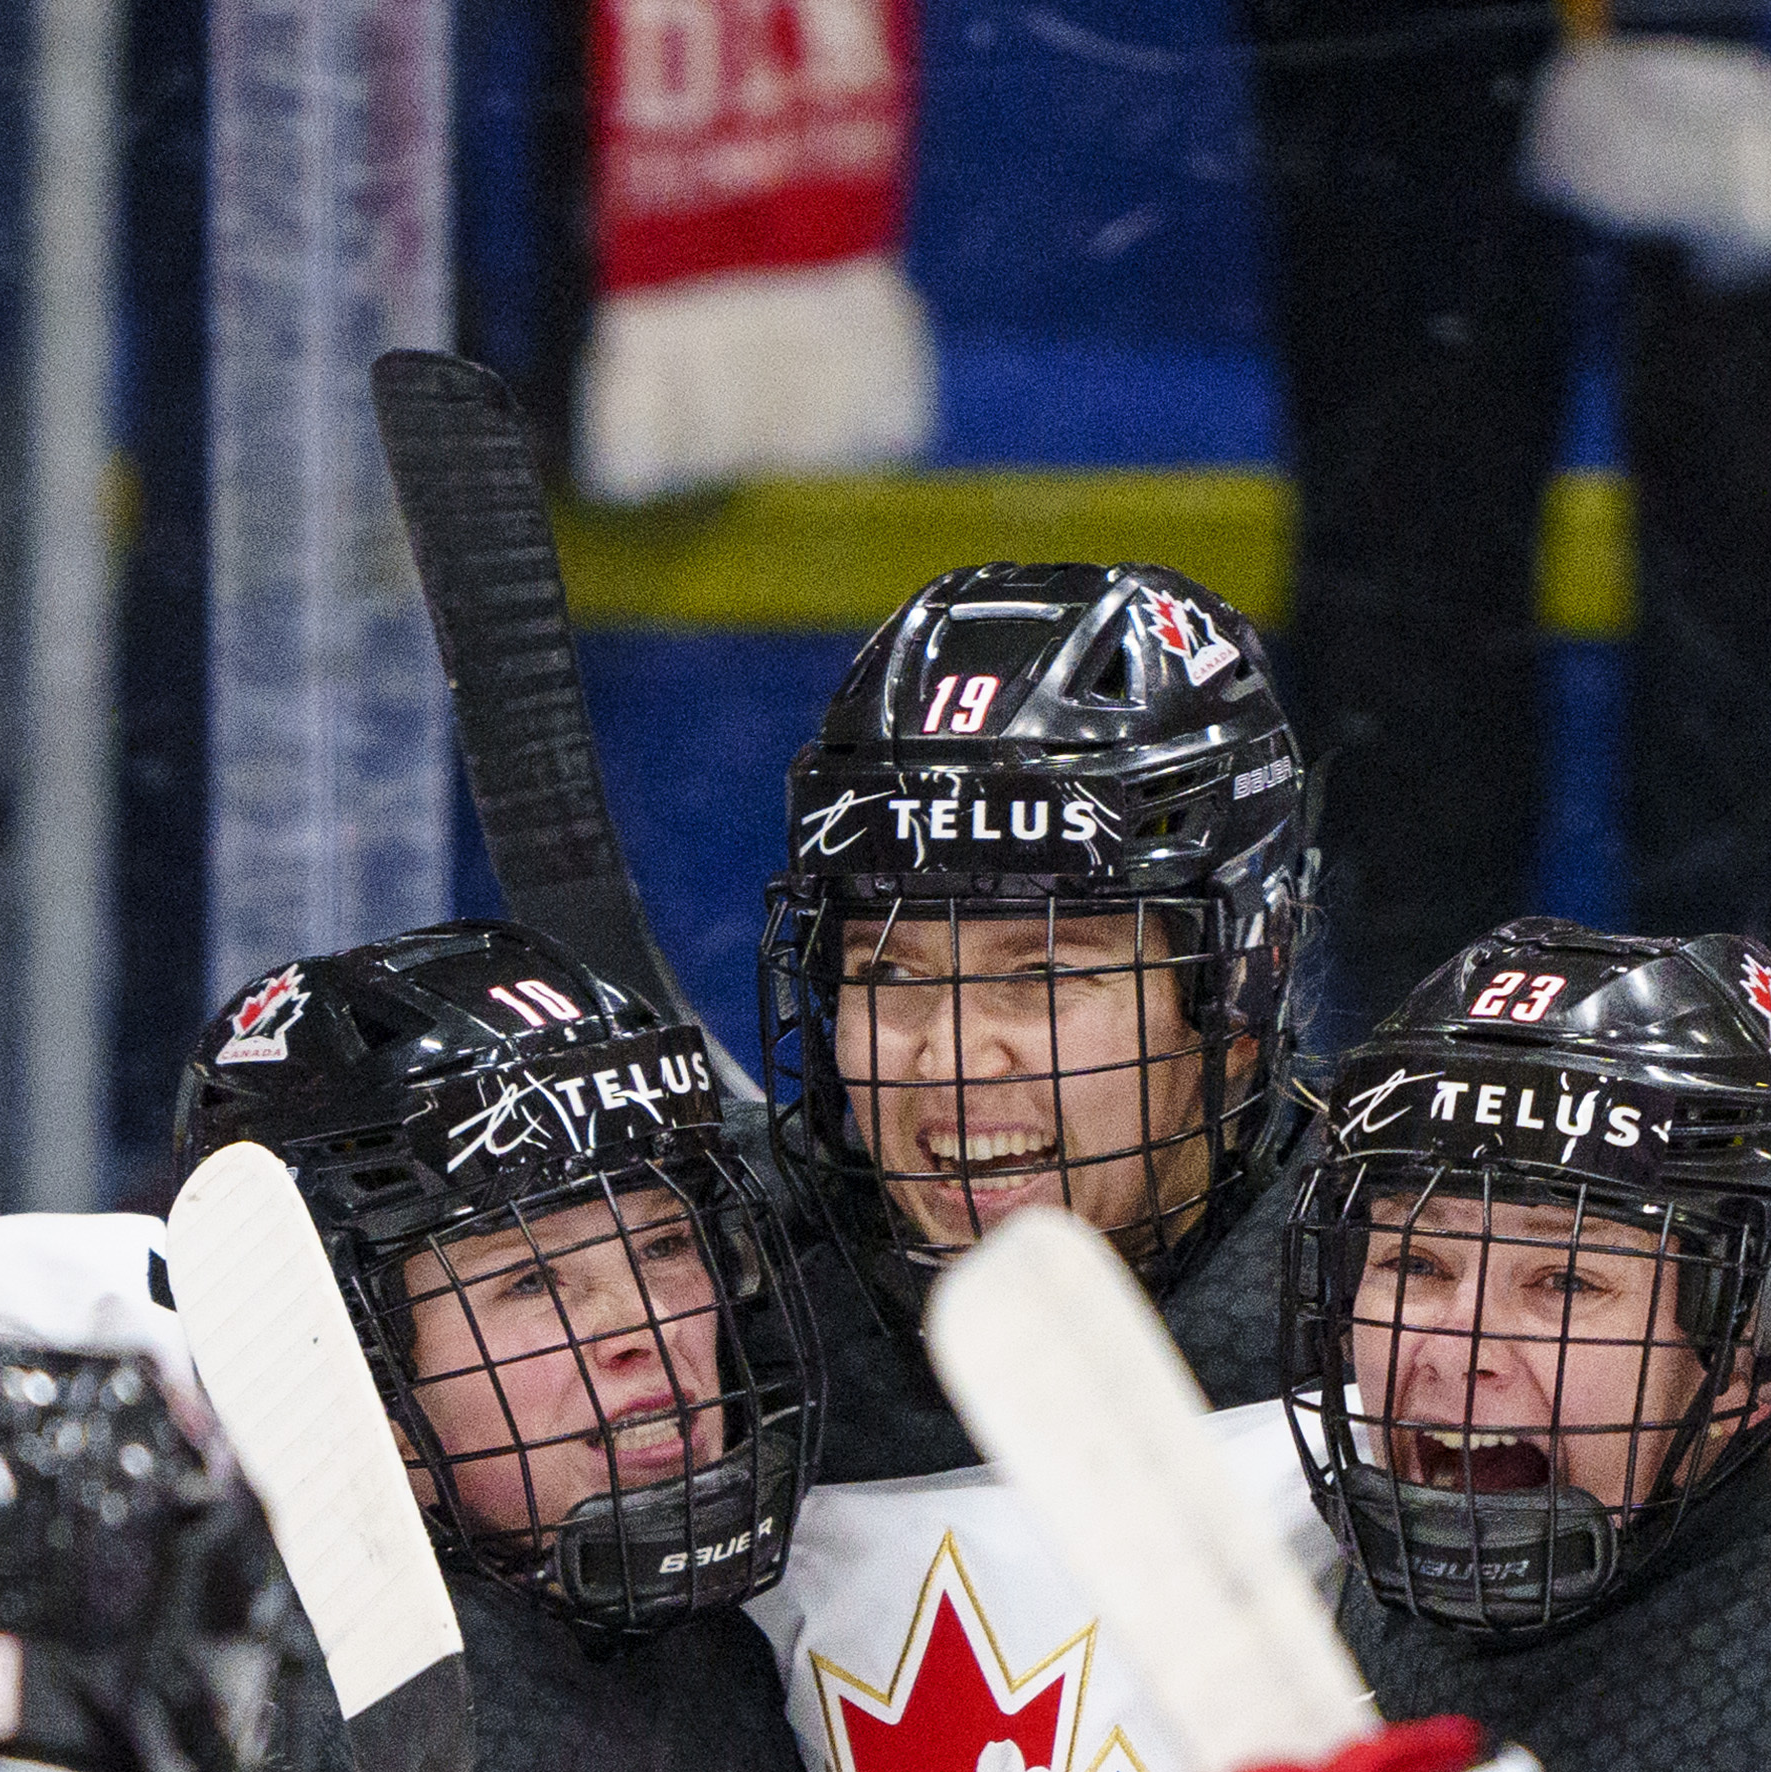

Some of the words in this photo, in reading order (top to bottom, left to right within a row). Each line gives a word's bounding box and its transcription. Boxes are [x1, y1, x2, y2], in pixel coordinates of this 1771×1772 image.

[922, 673, 1001, 734] 19
[888, 800, 1099, 841] TELUS
[488, 979, 583, 1027] 10
[1469, 971, 1566, 1022] 23
[554, 1051, 711, 1118] TELUS
[1431, 1080, 1642, 1148] TELUS
